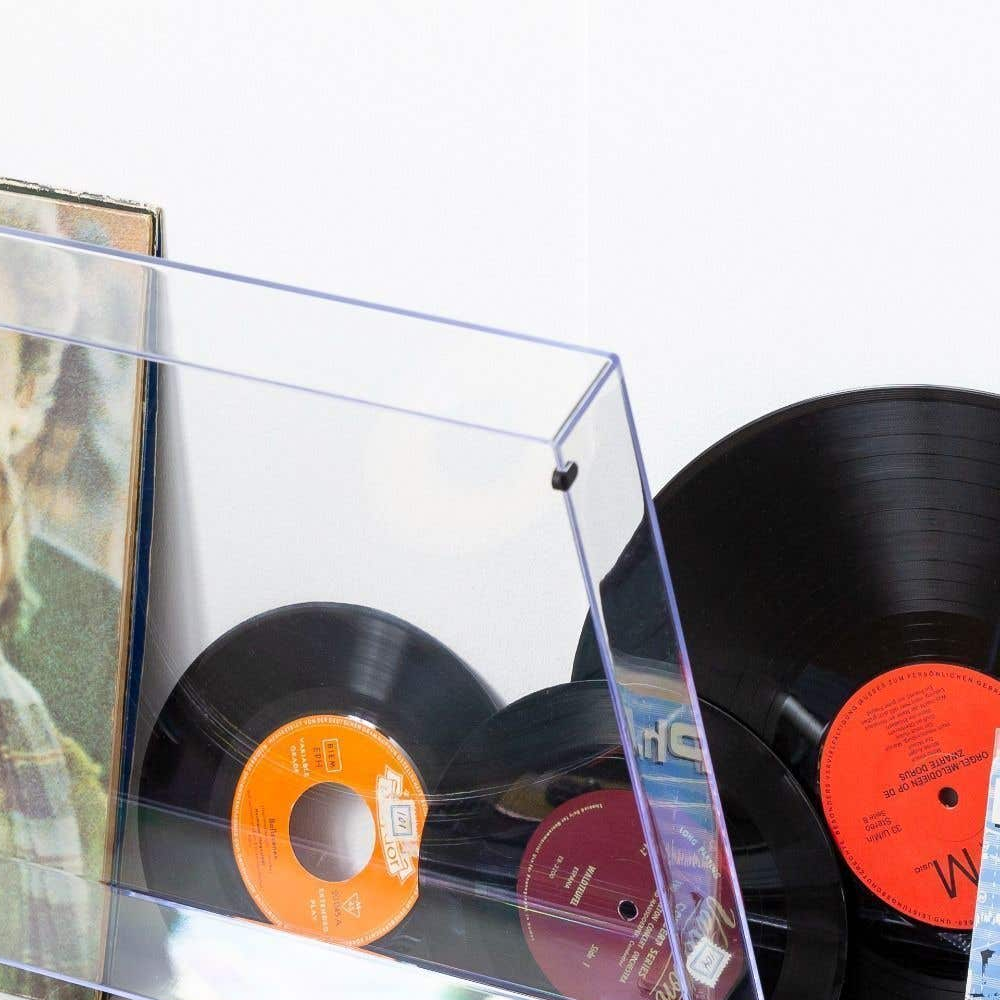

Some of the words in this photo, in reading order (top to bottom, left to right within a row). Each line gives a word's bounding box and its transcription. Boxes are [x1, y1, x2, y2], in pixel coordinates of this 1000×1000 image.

[930, 748, 965, 767] ZWARTE
[899, 764, 929, 781] DORUS
[883, 788, 896, 799] DE
[864, 817, 892, 831] Stereo
[679, 827, 698, 846] LONG
[569, 865, 597, 907] WALDTEUFEL
[638, 922, 654, 949] CONCERT
[619, 950, 640, 984] ORCHESTRA
[639, 947, 658, 979] SERIES
